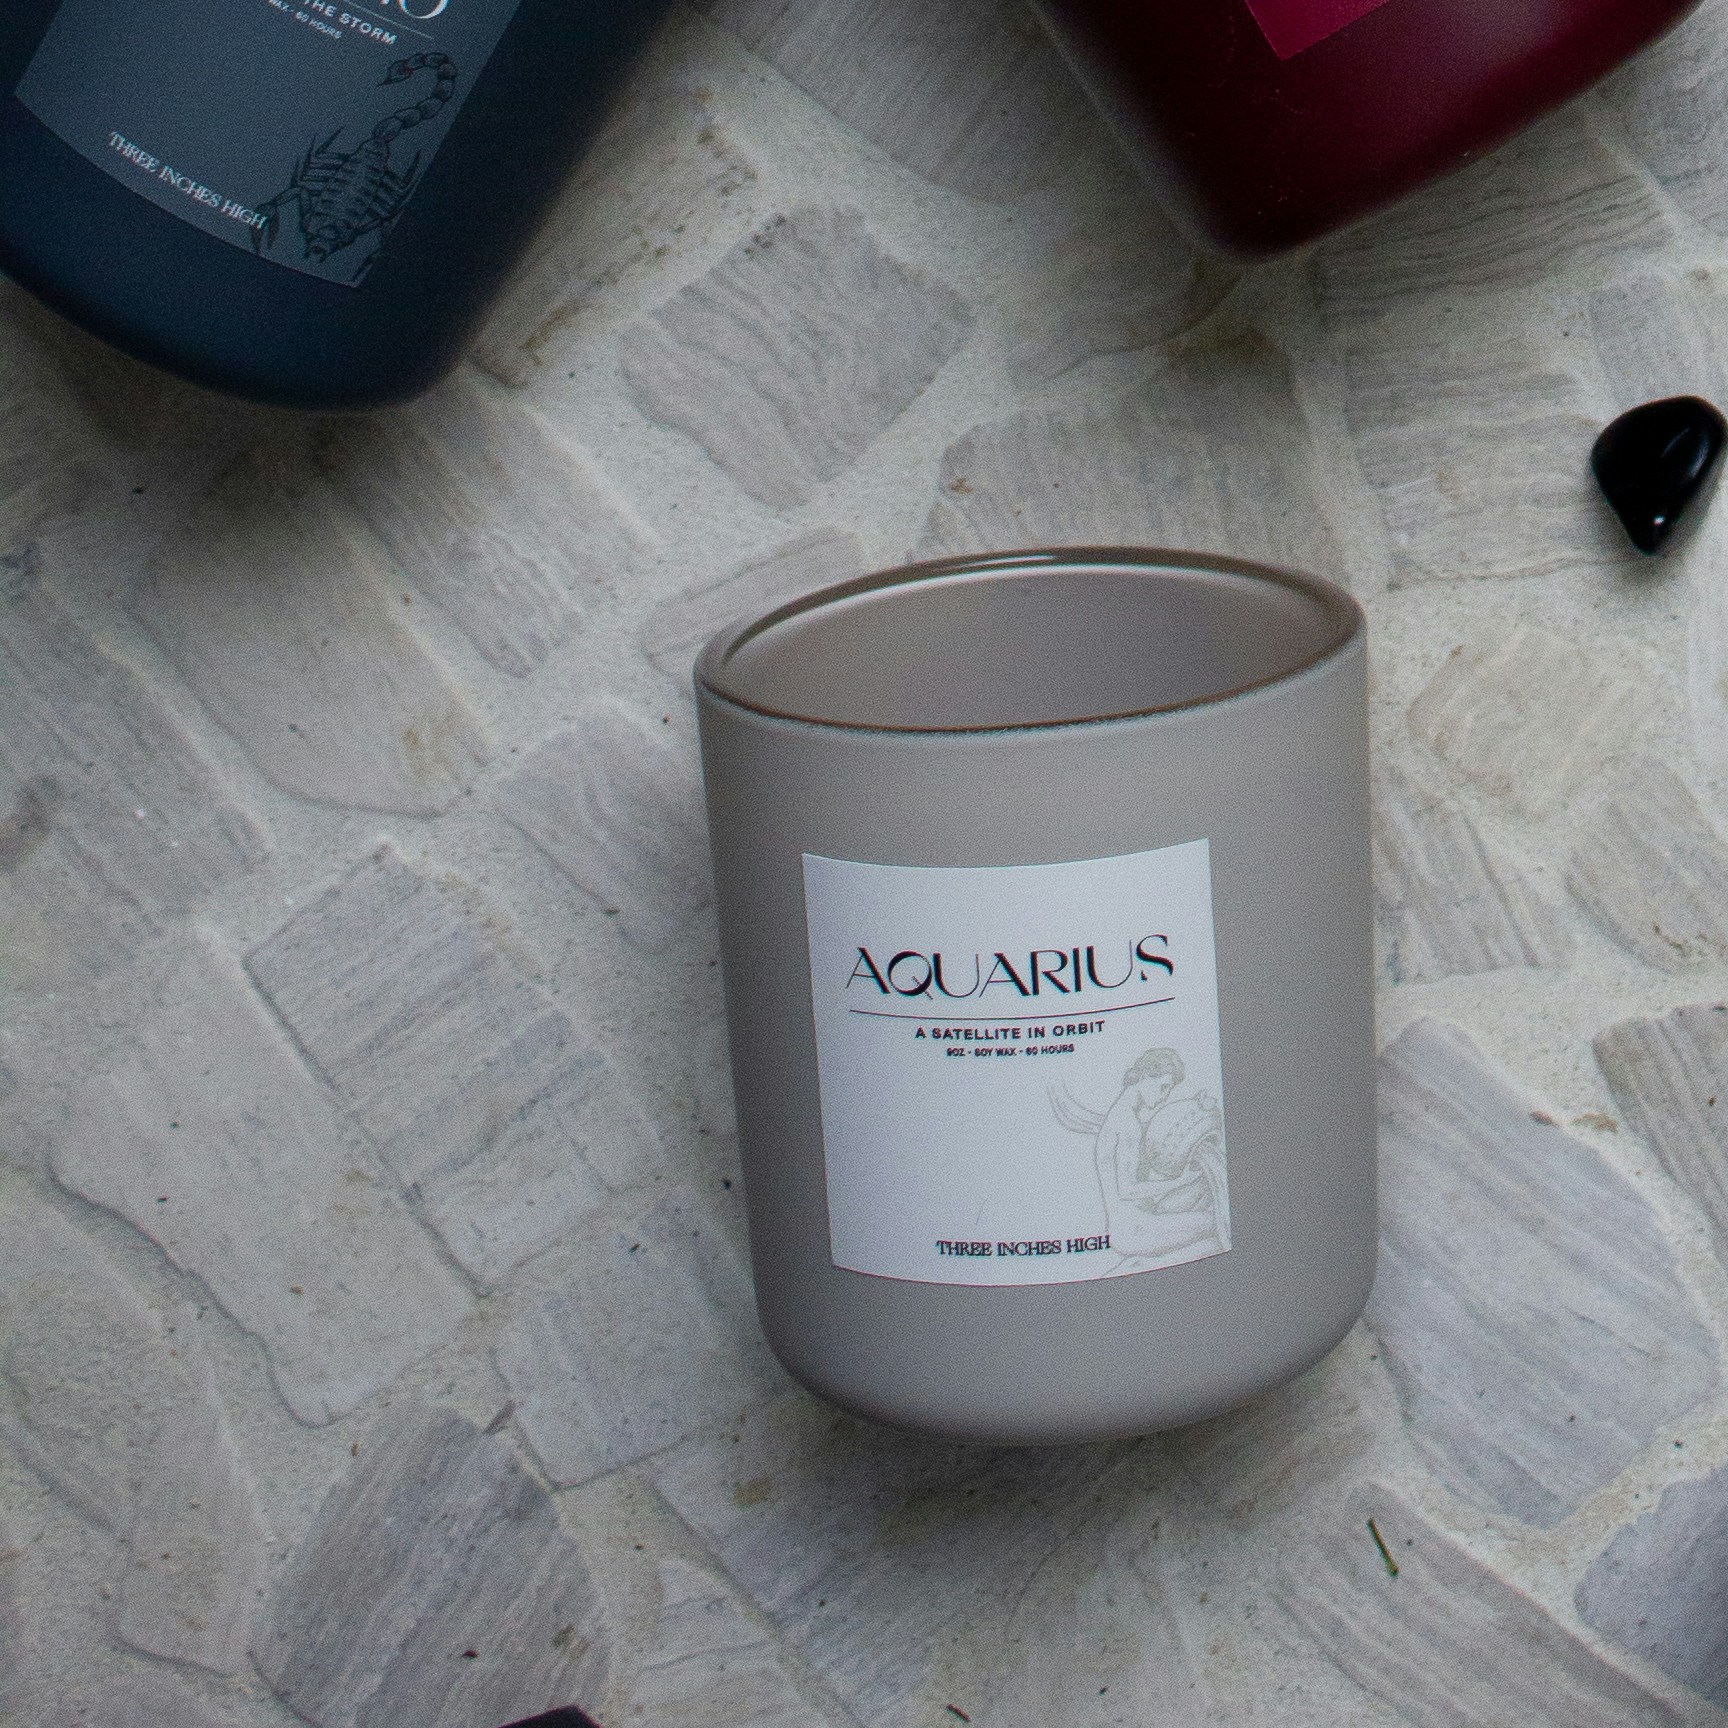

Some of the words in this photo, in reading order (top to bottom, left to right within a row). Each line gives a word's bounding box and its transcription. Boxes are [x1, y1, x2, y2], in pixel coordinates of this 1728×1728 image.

[339, 12, 397, 45] STORM
[109, 130, 160, 174] THREE
[158, 165, 222, 208] INCHES
[220, 199, 267, 230] HIGH
[846, 934, 1174, 1000] AQUARIUS
[914, 1027, 927, 1039] A
[931, 1027, 1021, 1041] SATELLITE
[1027, 1026, 1046, 1039] IN
[1052, 1020, 1105, 1037] ORBIT
[935, 1239, 993, 1258] THREE
[996, 1239, 1063, 1258] INCHES
[1066, 1234, 1112, 1254] HIGH
